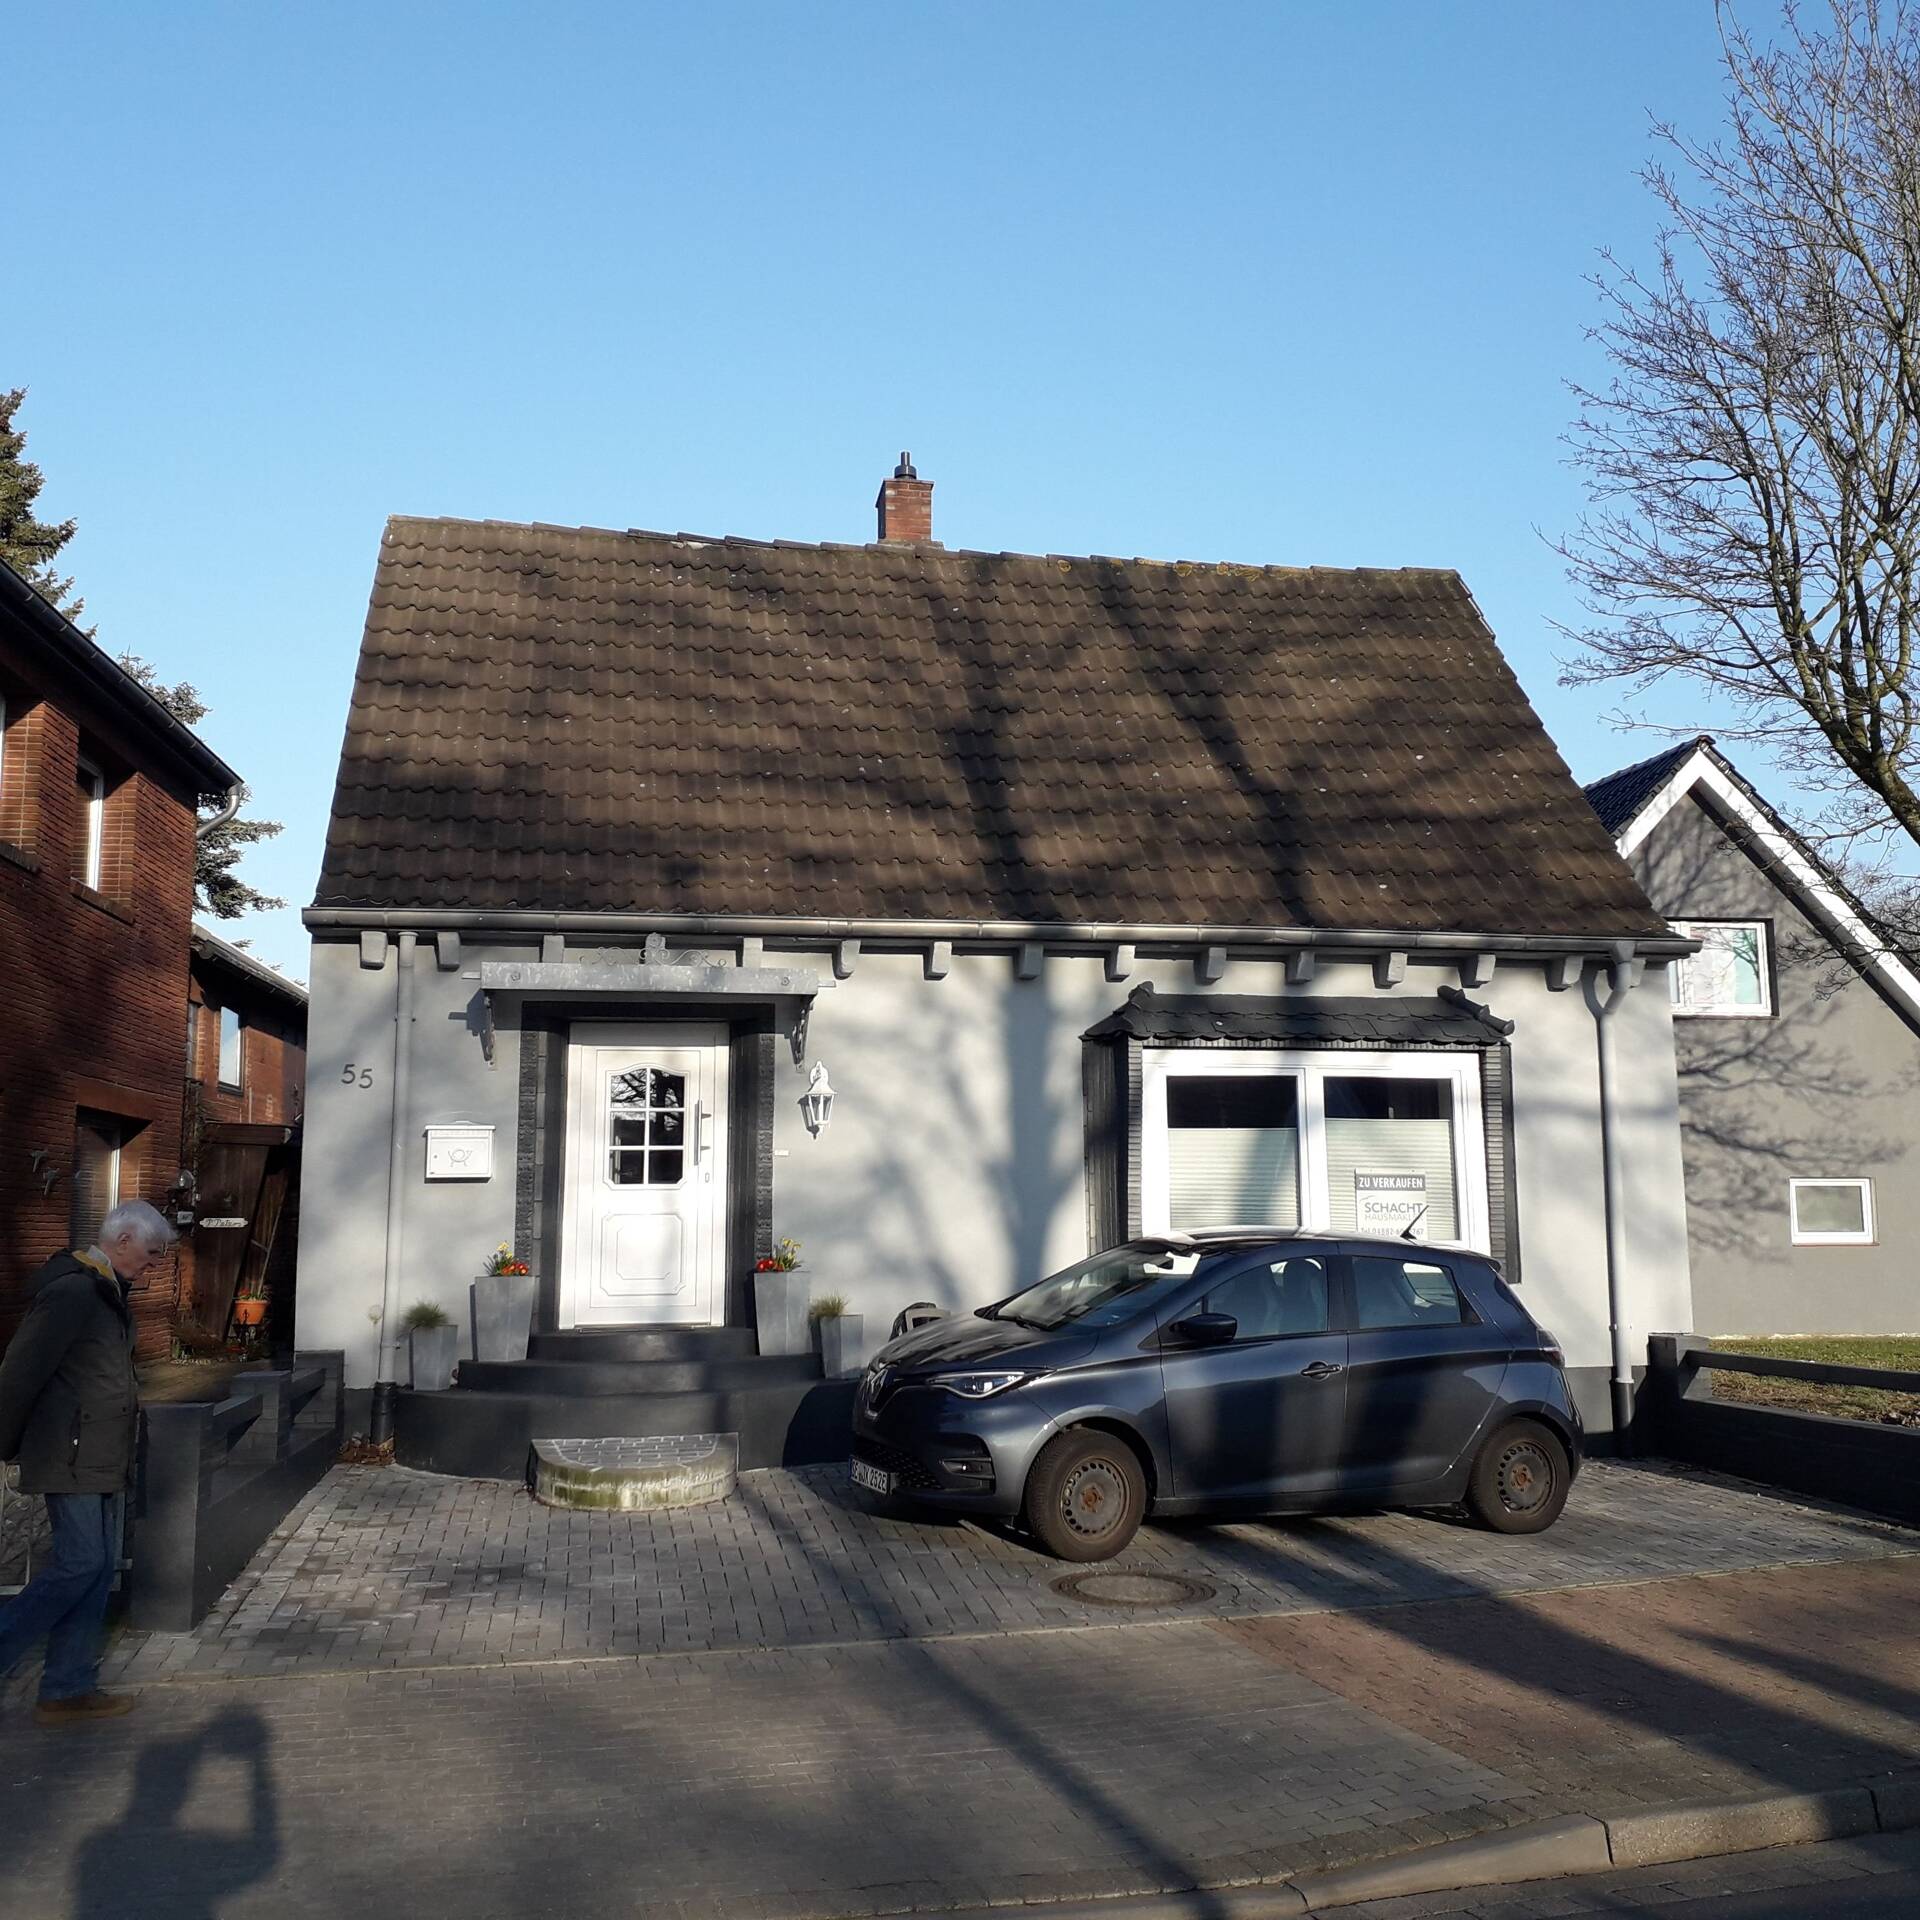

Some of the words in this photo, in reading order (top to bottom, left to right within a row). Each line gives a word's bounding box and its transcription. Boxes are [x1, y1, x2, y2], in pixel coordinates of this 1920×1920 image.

[341, 1064, 373, 1089] 55
[1359, 1177, 1370, 1188] ZU
[1373, 1177, 1423, 1188] VERKAUFEN
[1364, 1202, 1423, 1213] SCHACHT
